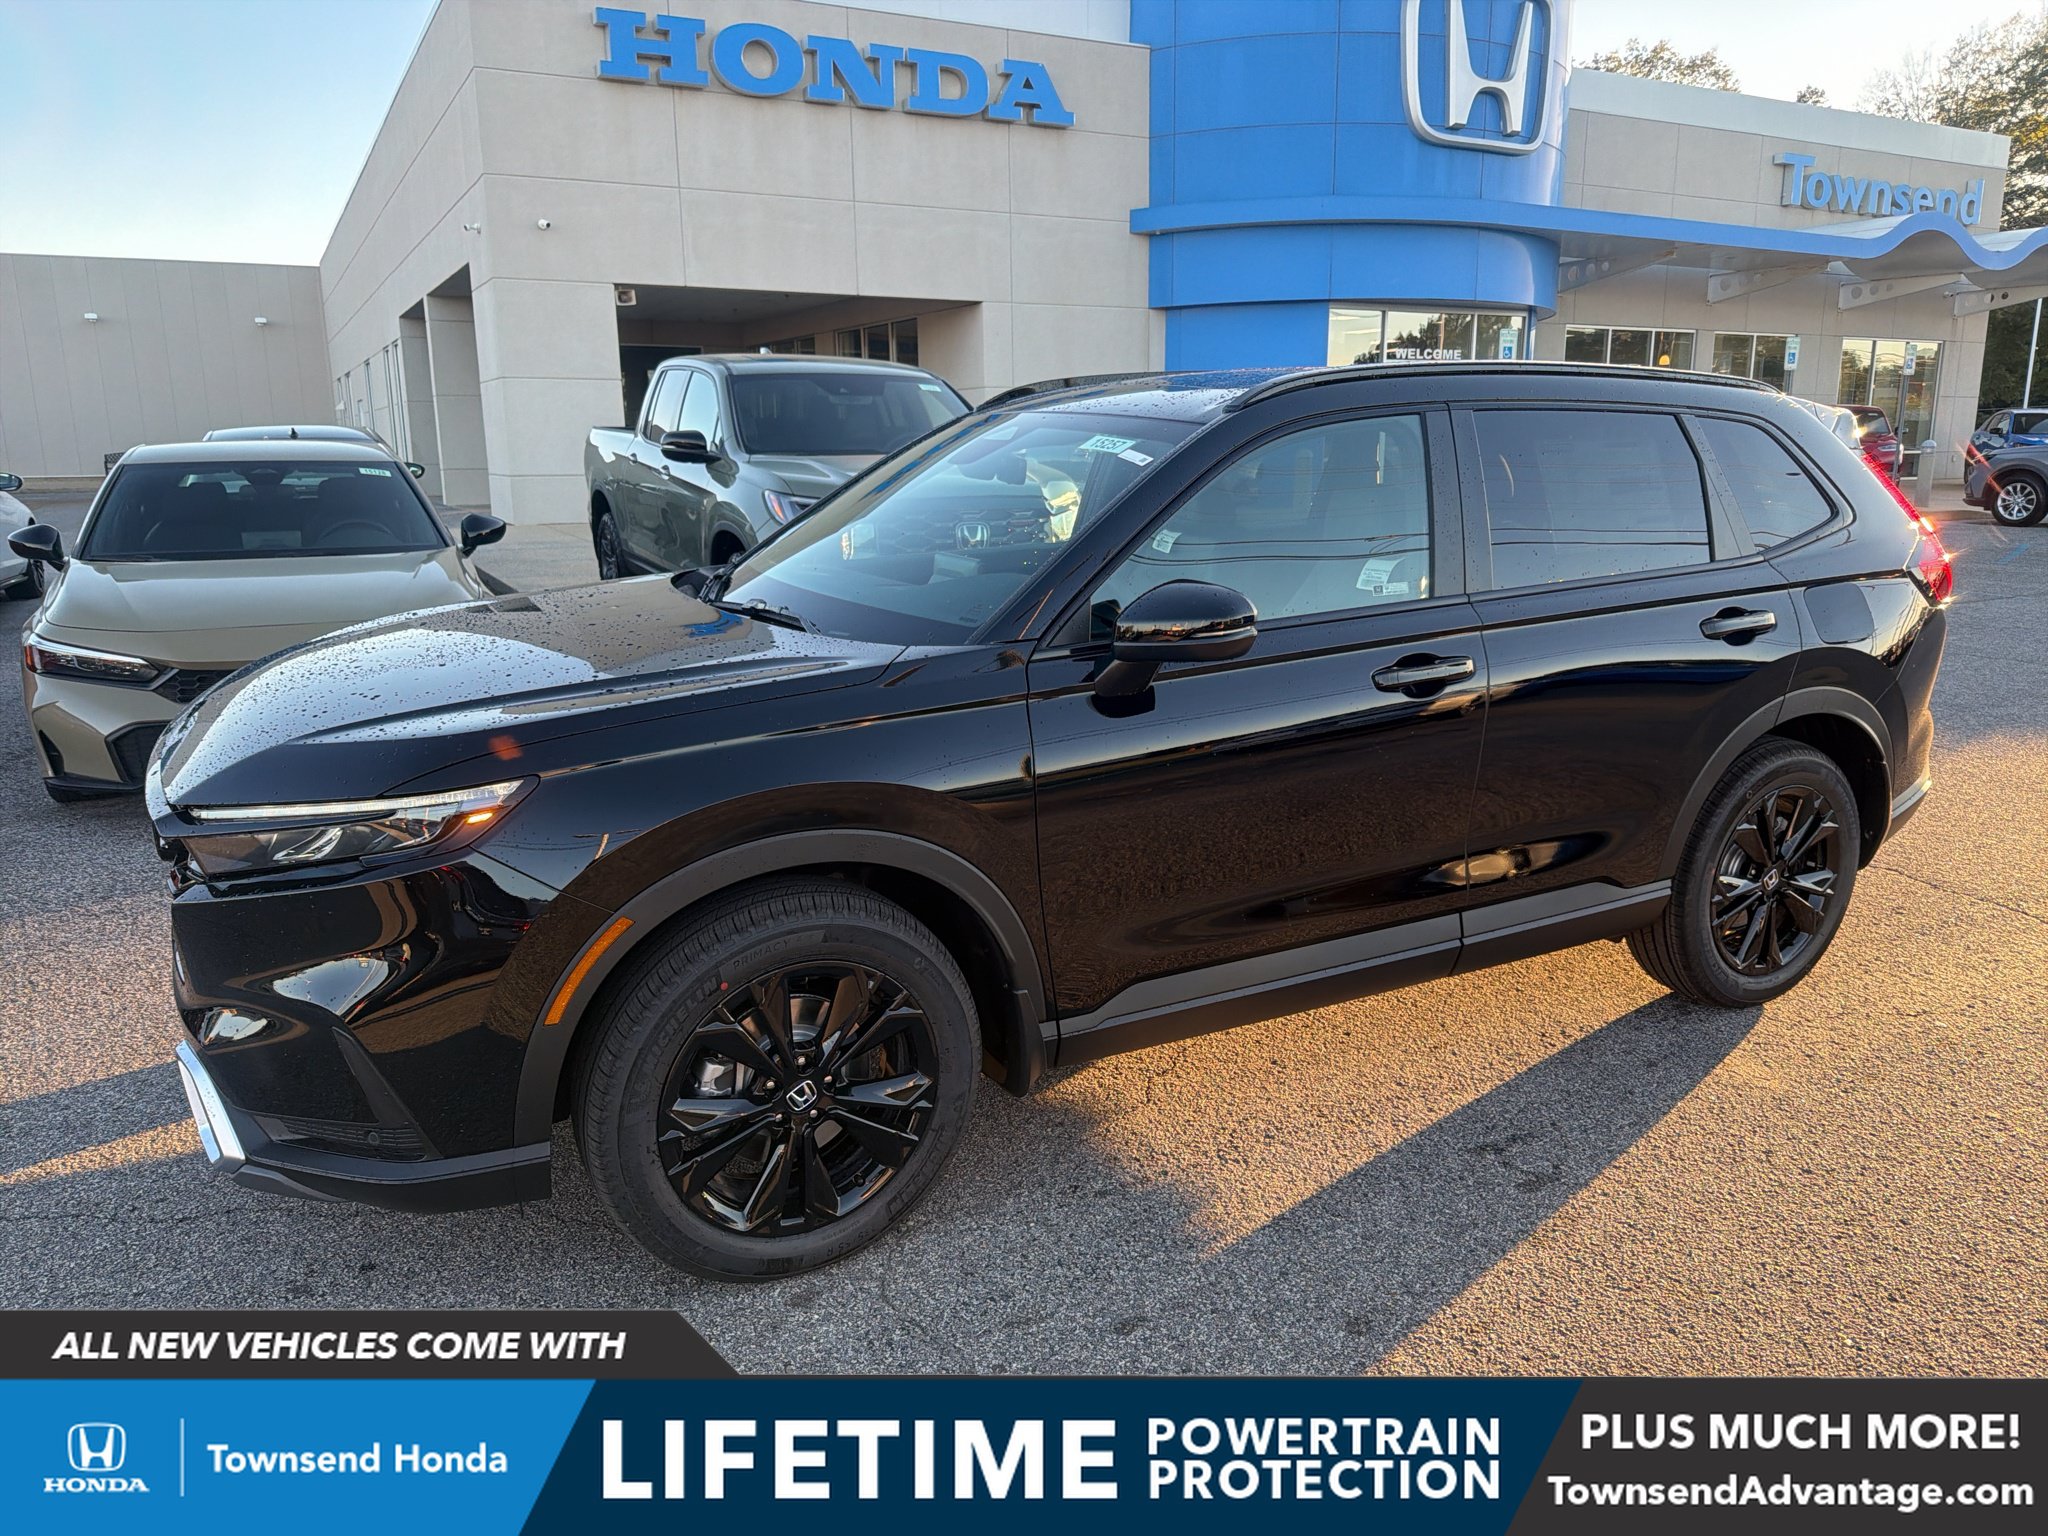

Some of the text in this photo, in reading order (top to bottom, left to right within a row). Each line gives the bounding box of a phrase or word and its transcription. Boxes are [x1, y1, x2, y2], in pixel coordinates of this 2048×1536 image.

[593, 6, 1076, 128] HONDA
[1773, 152, 1985, 226] Townsend
[1396, 348, 1462, 360] WELCOME
[732, 939, 790, 970] PRIMACY
